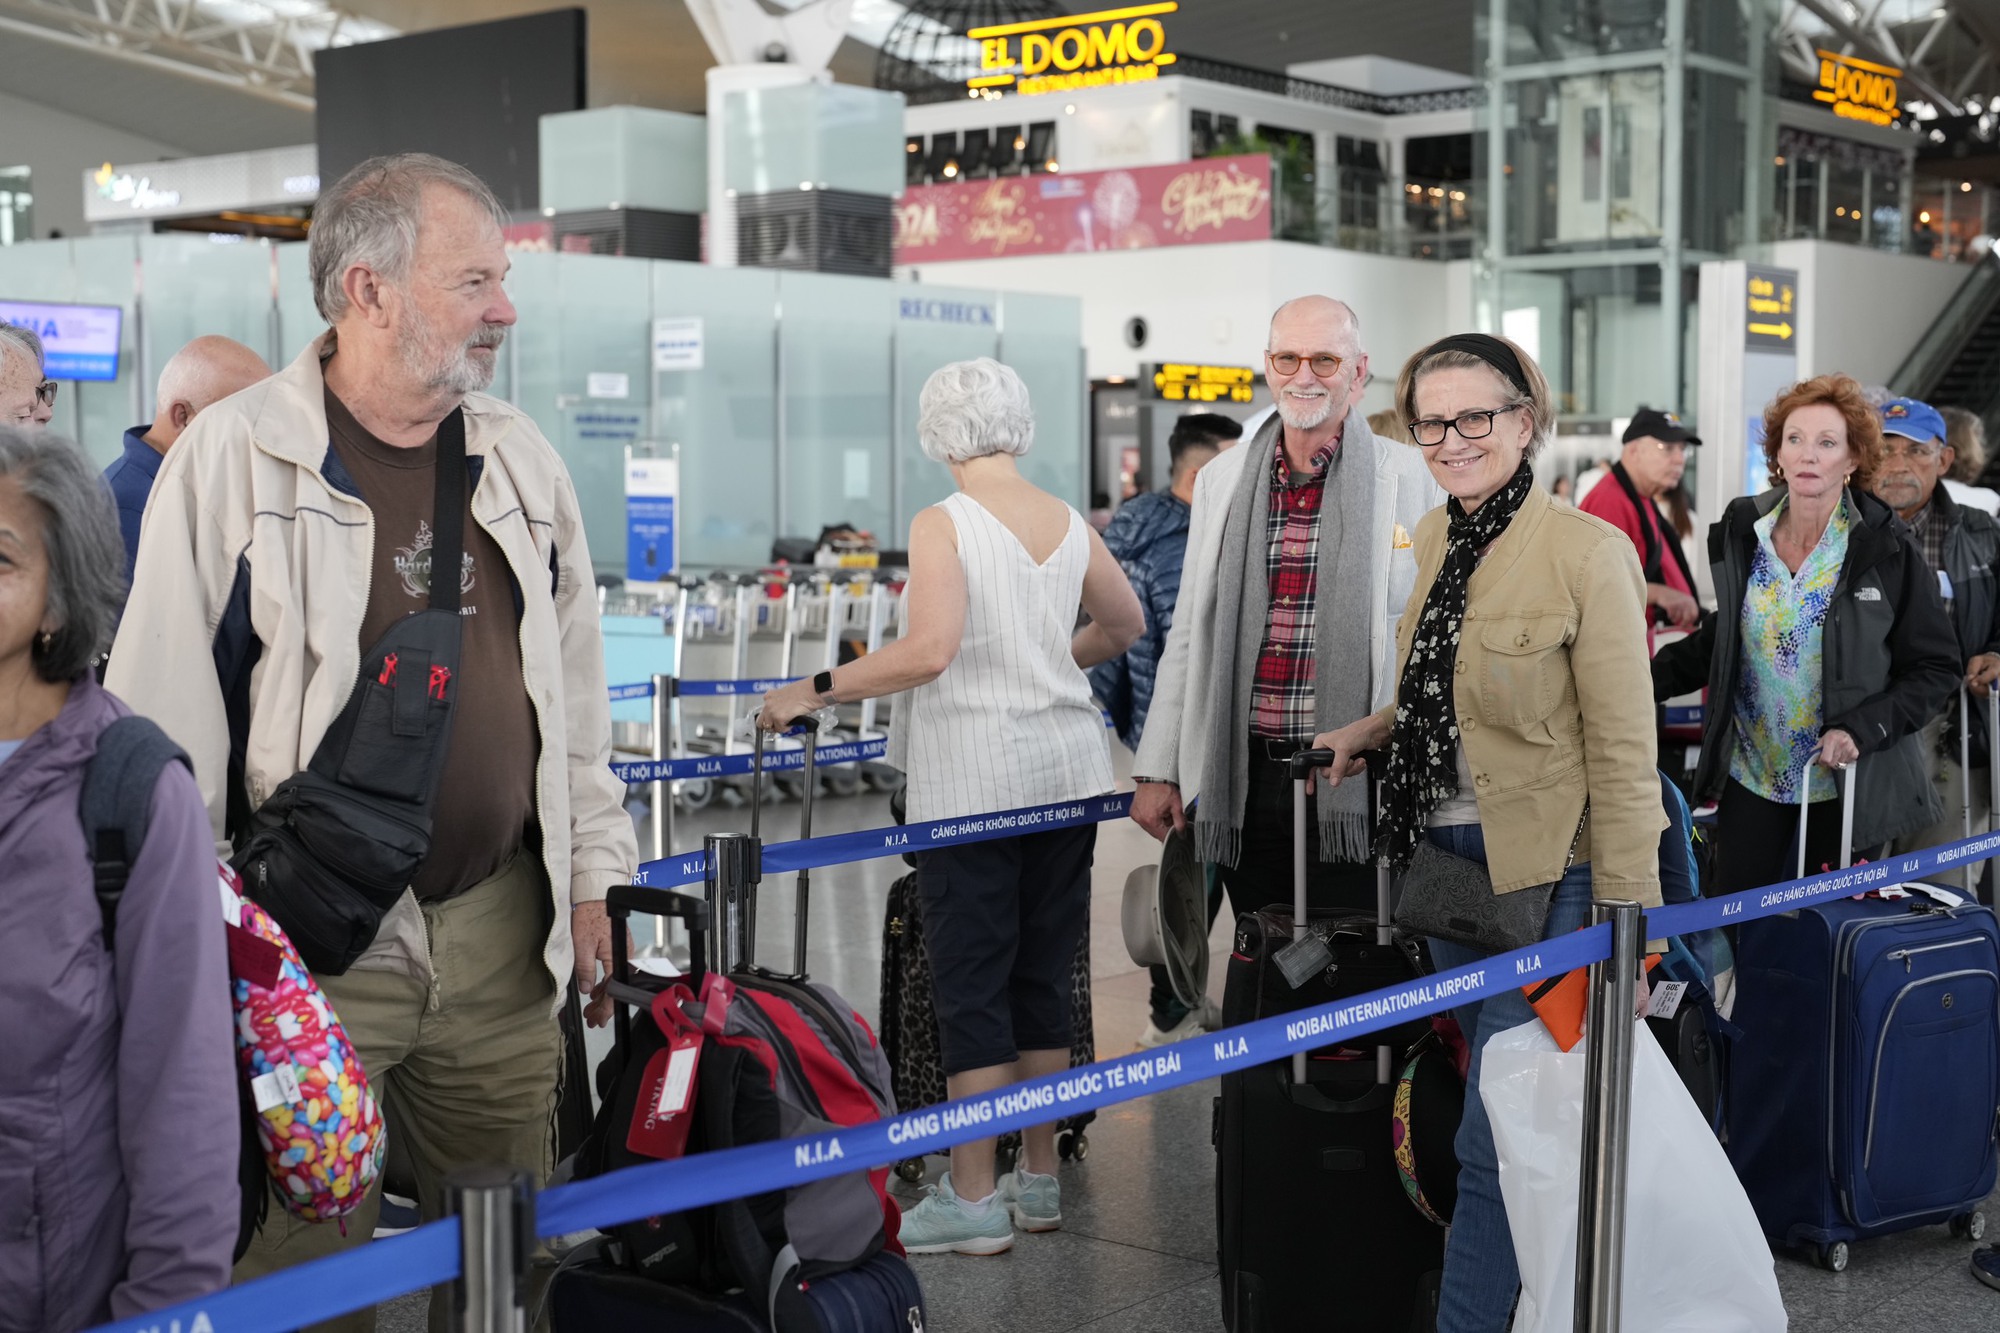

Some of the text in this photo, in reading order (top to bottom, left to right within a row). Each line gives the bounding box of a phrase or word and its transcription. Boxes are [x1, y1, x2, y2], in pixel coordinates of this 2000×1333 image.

[981, 17, 1165, 75] EL DOMO
[1835, 65, 1897, 111] DOMO
[393, 555, 432, 574] Hard
[631, 765, 650, 781] NỘI
[697, 762, 722, 774] N.I.A
[748, 755, 781, 768] NIBAI
[785, 745, 859, 765] INTENATIONAL
[885, 832, 908, 847] N.I.A
[986, 816, 1016, 831] KHÔNG
[1043, 808, 1054, 822] TẾ
[1056, 808, 1070, 821] NỘI
[1103, 800, 1122, 813] N.I.A
[1722, 901, 1743, 916] N.I.A
[1783, 886, 1805, 903] HÀNG
[1805, 879, 1832, 899] KHÔNG
[1832, 874, 1853, 890] QUỐC
[1854, 871, 1863, 885] TẾ
[1863, 869, 1876, 884] NỘI
[1903, 859, 1919, 873] N.I.A
[1937, 848, 1960, 864] NOIBAI
[1665, 983, 1680, 991] 309
[795, 1137, 844, 1168] N.I.A
[995, 1085, 1055, 1118] KHÔNG
[1105, 1064, 1126, 1089] TẾ
[1127, 1059, 1153, 1085] NỘI
[1214, 1036, 1249, 1061] N.I.A
[1287, 1016, 1334, 1042] NOIBAI
[1335, 992, 1434, 1029] INTERNATIONAL
[1435, 970, 1486, 1000] AIRPORT
[1516, 954, 1542, 975] N.I.A
[644, 1077, 664, 1131] VIKING
